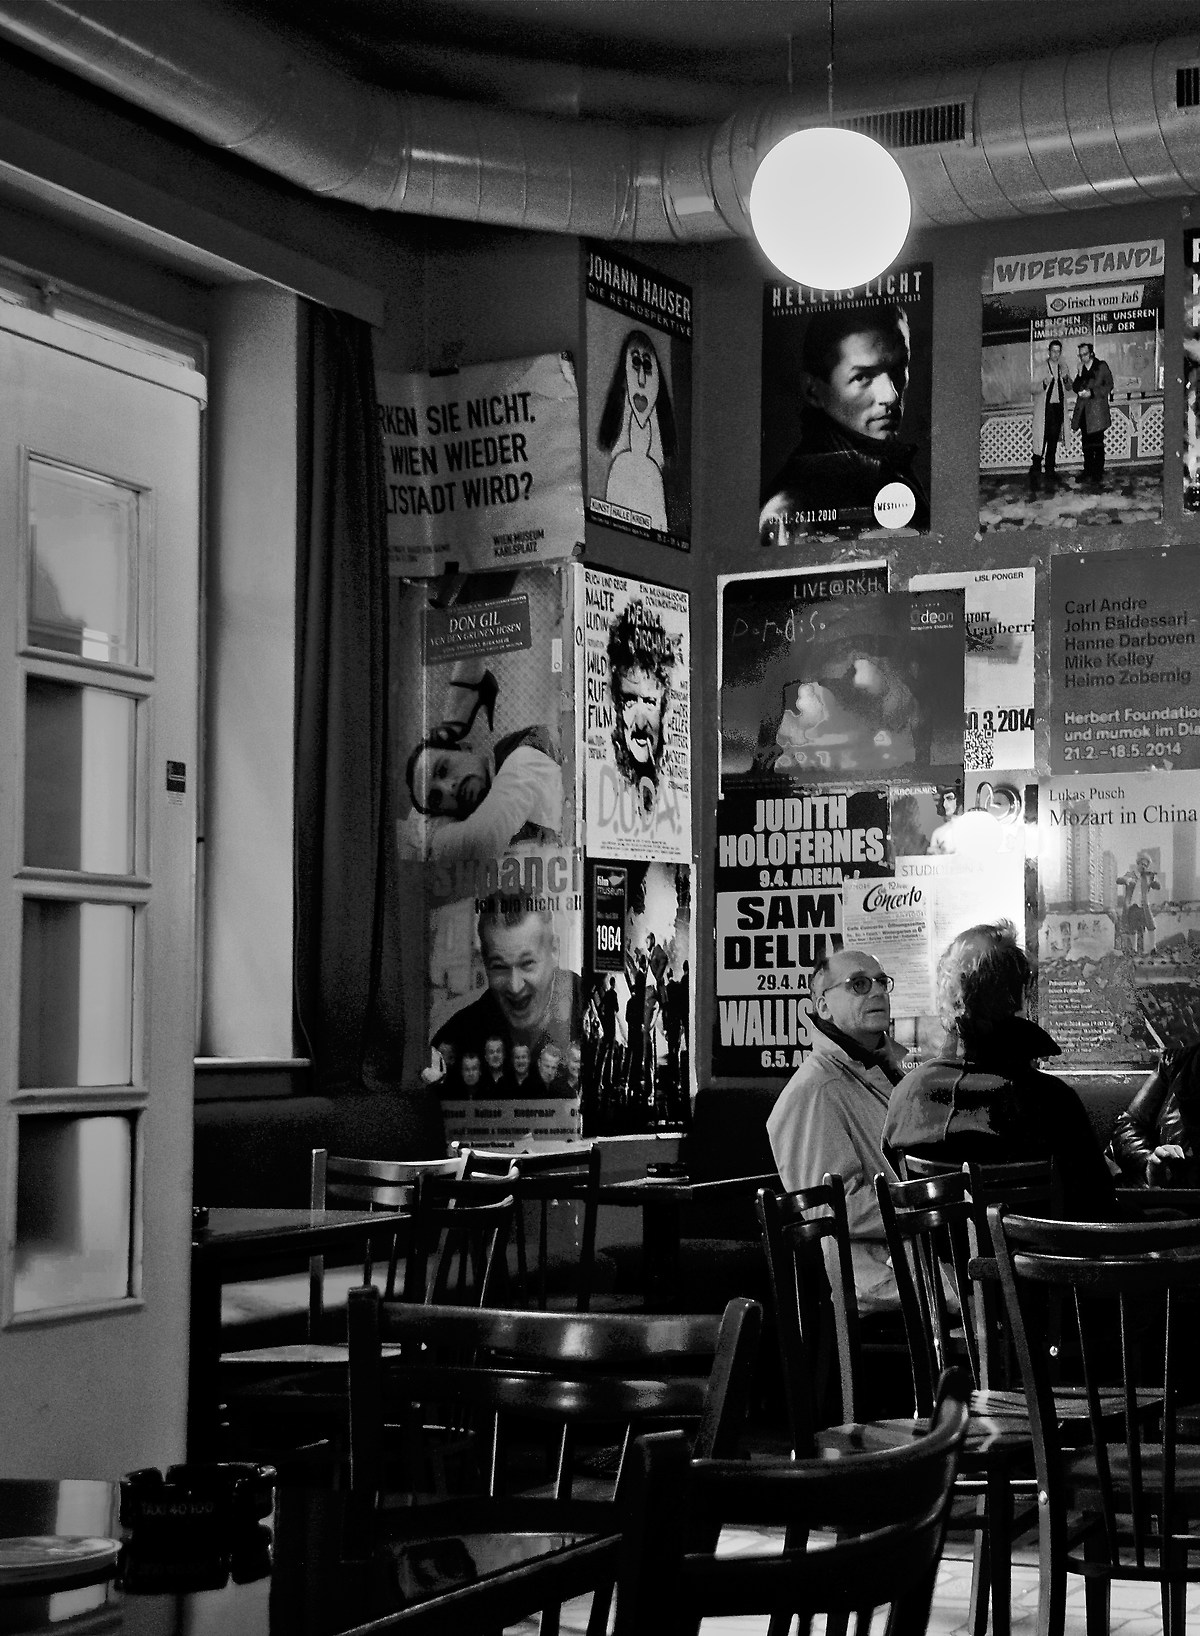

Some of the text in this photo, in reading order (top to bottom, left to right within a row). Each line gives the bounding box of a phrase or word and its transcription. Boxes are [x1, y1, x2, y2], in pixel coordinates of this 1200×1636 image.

[996, 246, 1163, 283] WIDERSTANDL
[589, 253, 690, 322] JOHANN HAUSER
[866, 271, 922, 298] LICHT
[1067, 291, 1139, 309] frisch vom Faß
[1035, 316, 1081, 328] BESUCHEN
[1113, 309, 1155, 321] UNSEREN
[1096, 323, 1113, 333] AUF
[1118, 322, 1135, 331] DER
[426, 402, 461, 435] SIE
[468, 392, 536, 429] NICHT.
[391, 433, 528, 475] WIEN WIEDER
[462, 472, 533, 508] WIRD?
[992, 571, 1024, 580] PONGER
[1065, 597, 1147, 614] Carl Andre
[449, 611, 500, 633] DON GIL
[1064, 610, 1187, 633] John Baldessari
[1065, 632, 1195, 651] Hanne Darboven
[587, 651, 607, 676] WILD
[1065, 651, 1154, 670] Mike Kelley
[1065, 667, 1191, 689] Heimo Zobernig
[588, 678, 607, 701] RUF
[588, 705, 613, 729] FILM
[1064, 709, 1120, 725] Herbert
[1064, 727, 1092, 742] und
[1096, 724, 1150, 740] mumok
[1155, 723, 1174, 737] im
[1050, 786, 1125, 801] Lukas Pusch
[754, 795, 848, 832] JUDITH
[1050, 804, 1198, 826] Mozart in China
[719, 827, 884, 868] HOLOFERNES
[597, 875, 609, 886] film
[760, 870, 788, 887] 9.4.
[526, 895, 560, 912] nicht
[863, 884, 922, 912] Concerto
[737, 893, 843, 930] SAM
[596, 925, 621, 951] 1964
[757, 974, 793, 990] 29.4.
[719, 998, 813, 1046] WALLIS
[761, 1050, 789, 1067] 6.5.
